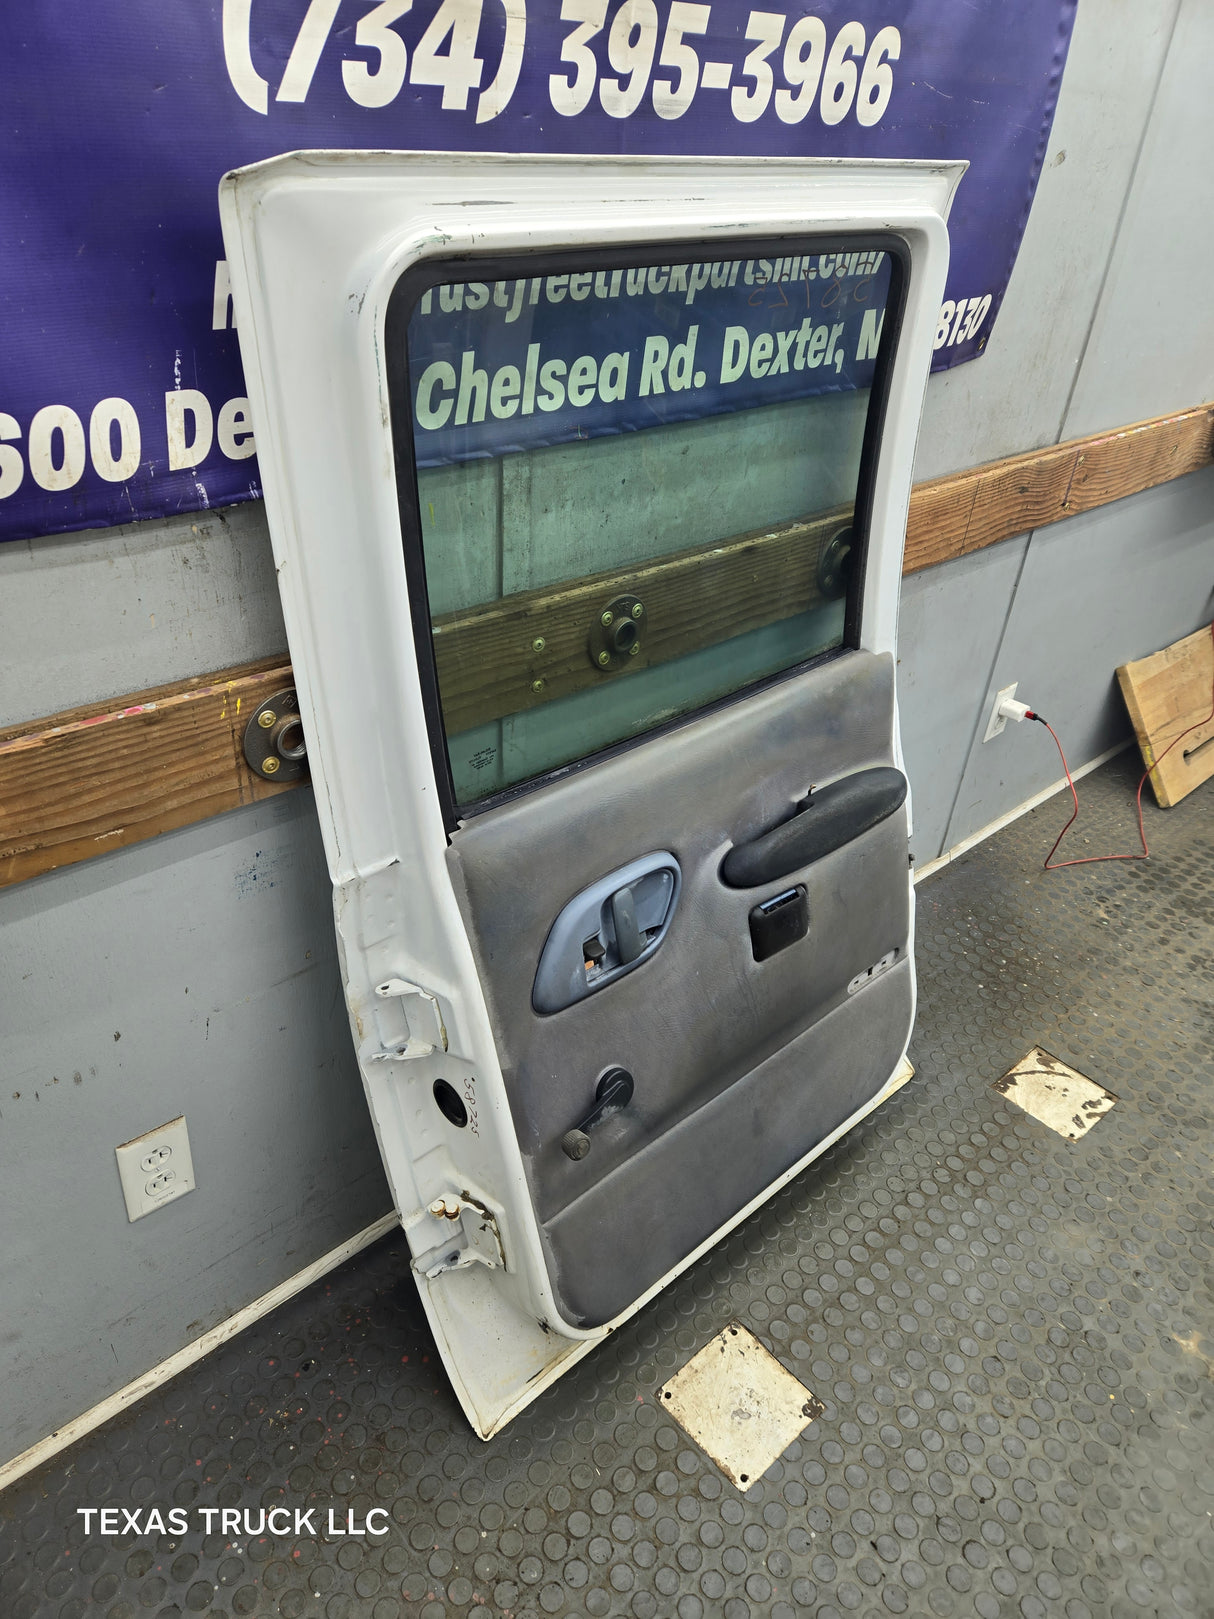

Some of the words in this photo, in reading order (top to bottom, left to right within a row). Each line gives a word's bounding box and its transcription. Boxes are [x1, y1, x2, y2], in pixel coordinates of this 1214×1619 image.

[222, 0, 527, 124] (734)
[549, 0, 901, 127] 395-3966
[416, 343, 630, 430] Chelsea
[638, 324, 707, 397] Rd.
[720, 317, 845, 384] Dexter,
